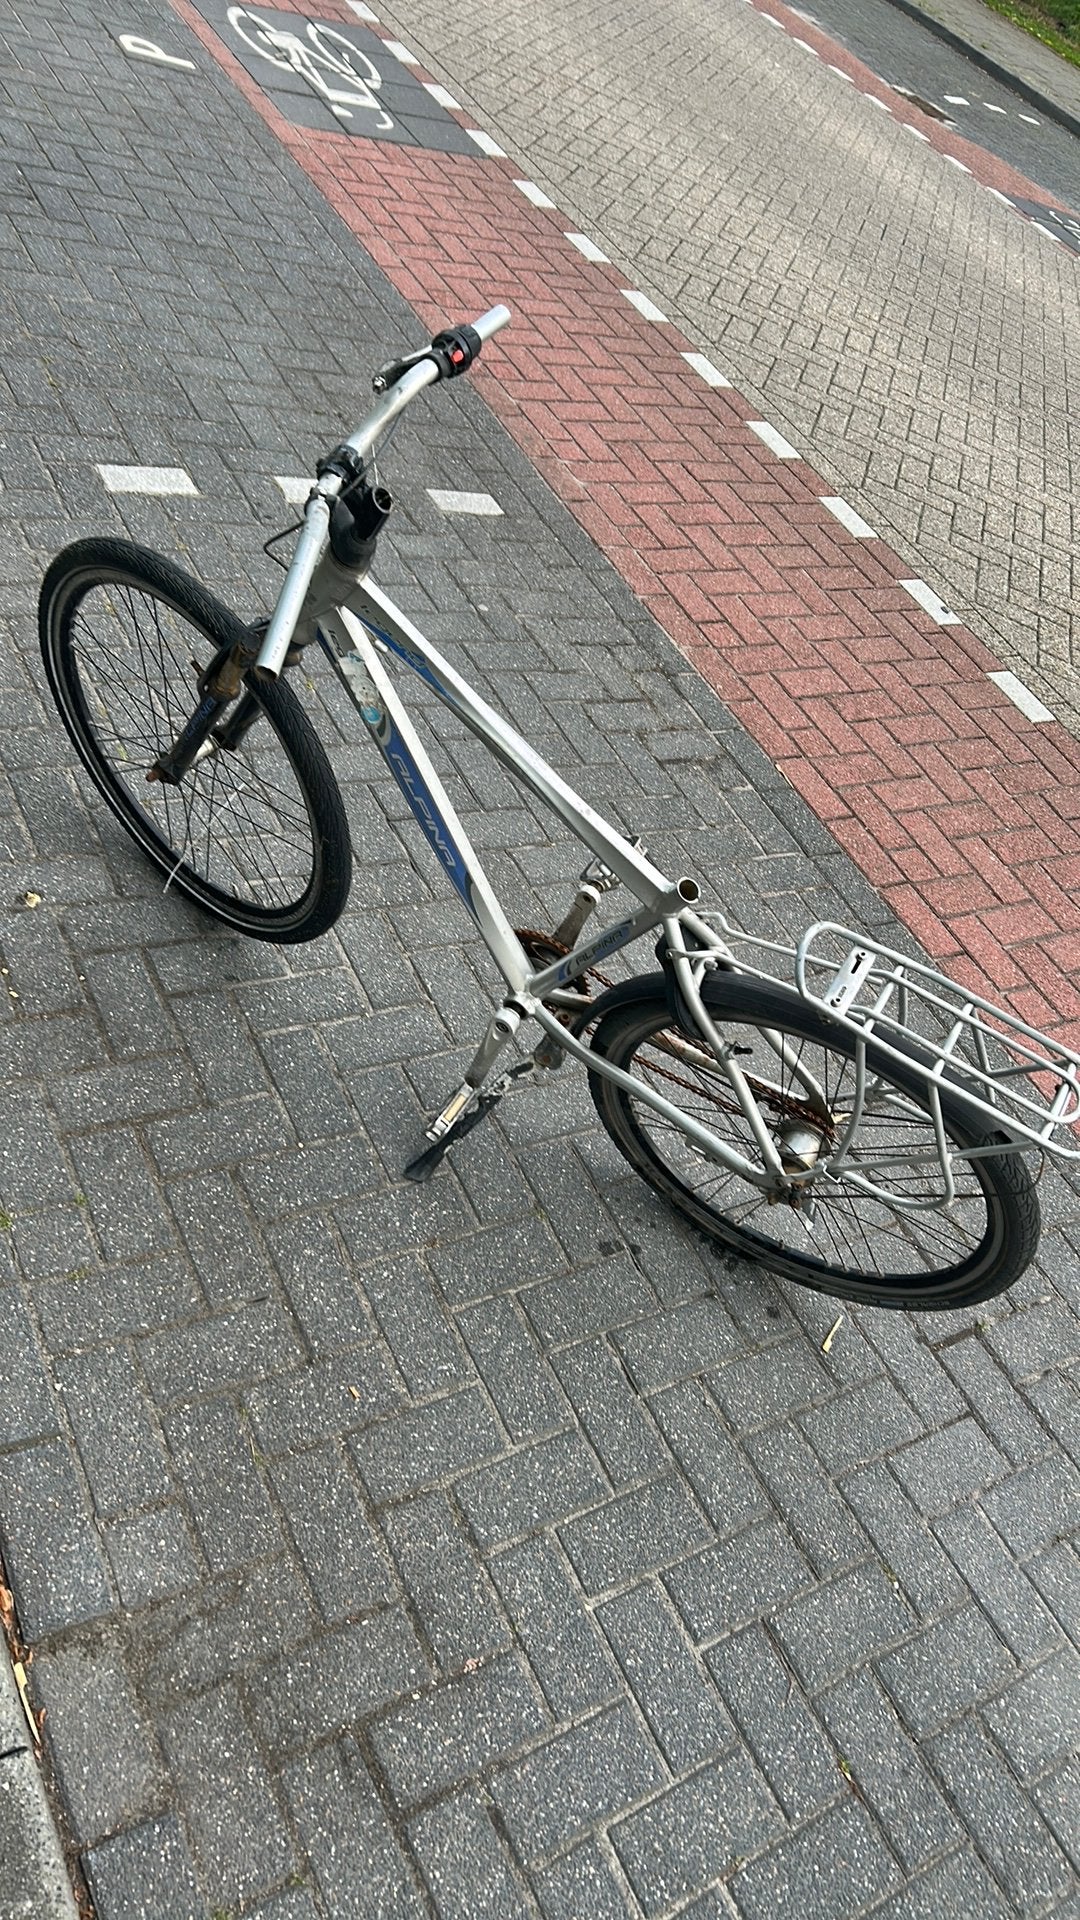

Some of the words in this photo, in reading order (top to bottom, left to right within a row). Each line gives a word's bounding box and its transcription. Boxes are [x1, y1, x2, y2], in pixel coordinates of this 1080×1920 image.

[119, 34, 196, 70] P
[391, 753, 457, 867] ALPINA
[575, 930, 623, 965] ALPINA
